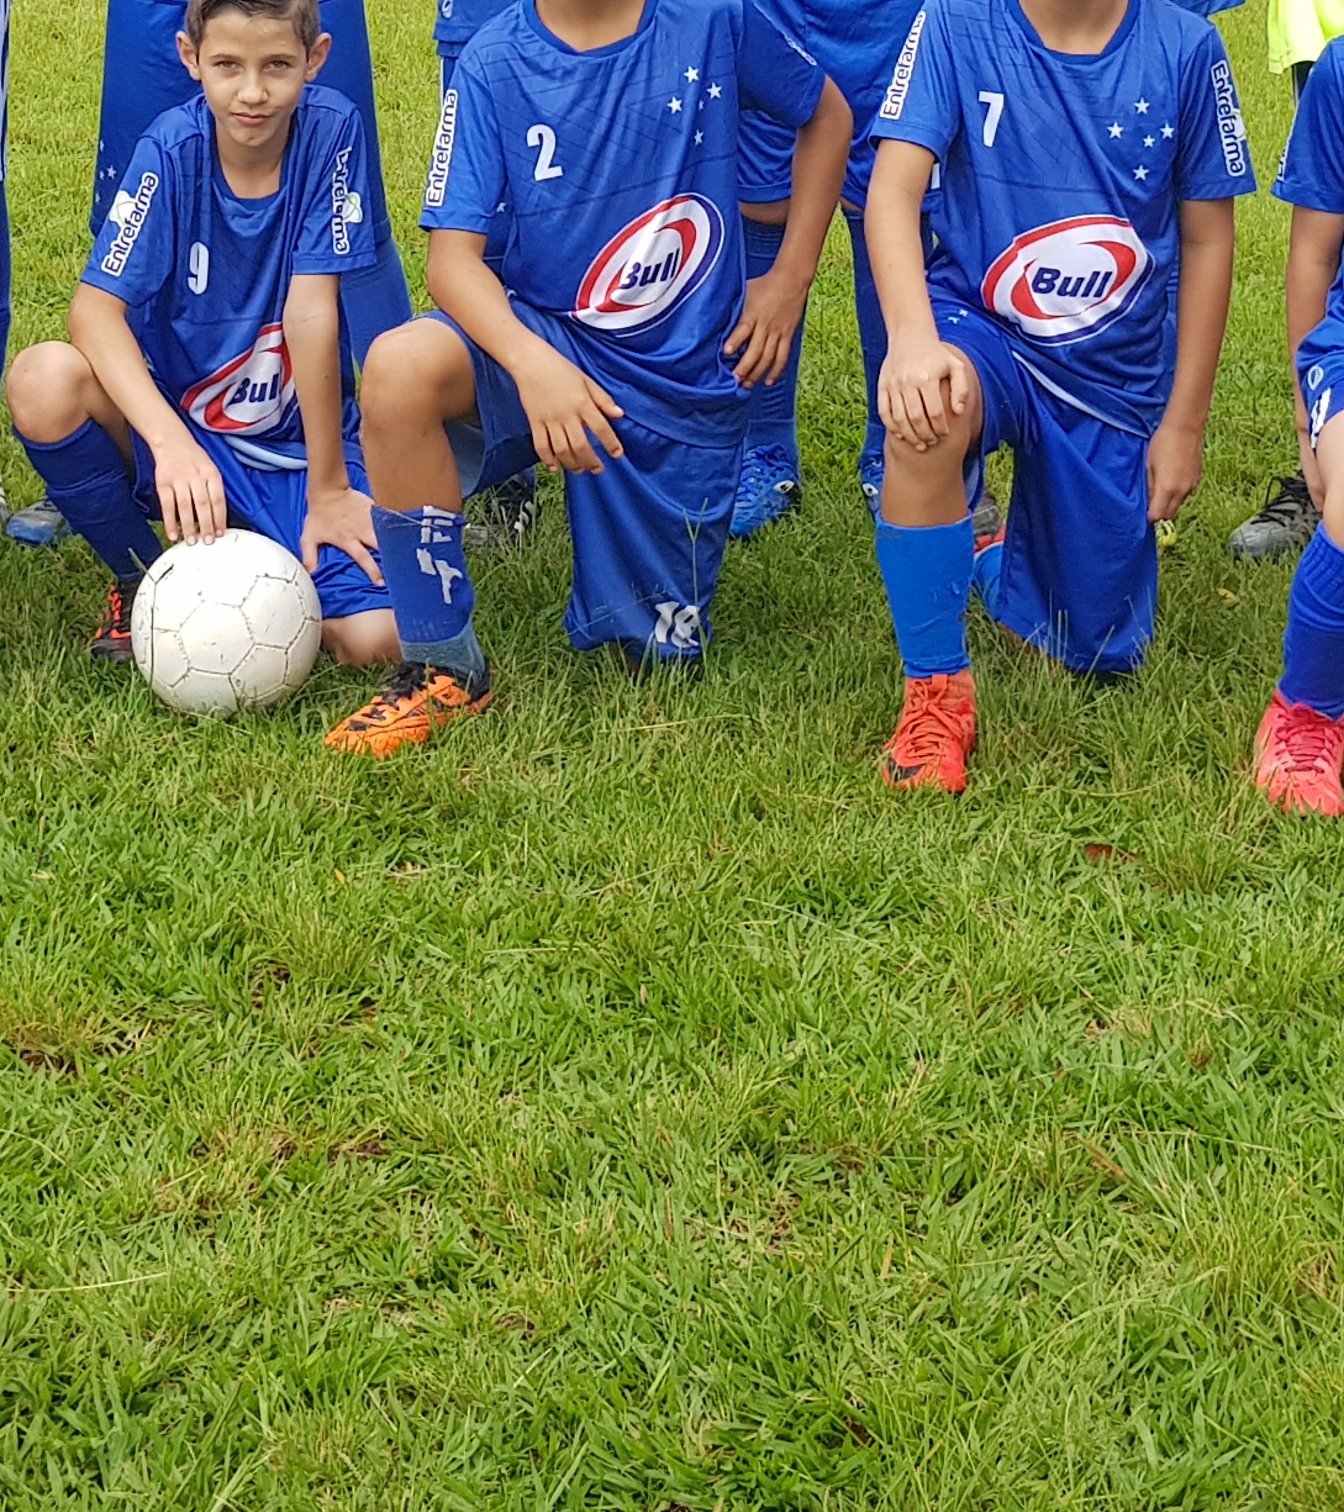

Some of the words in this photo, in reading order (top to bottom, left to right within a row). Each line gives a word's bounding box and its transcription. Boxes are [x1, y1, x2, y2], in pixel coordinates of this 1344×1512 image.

[978, 91, 1006, 148] 7
[1211, 60, 1246, 176] Entrefarma
[426, 90, 458, 206] Entrefarma
[525, 123, 564, 181] 2
[102, 172, 159, 277] Entrefarma
[187, 242, 210, 295] 9
[617, 247, 681, 290] Bull
[1032, 267, 1112, 300] Bull
